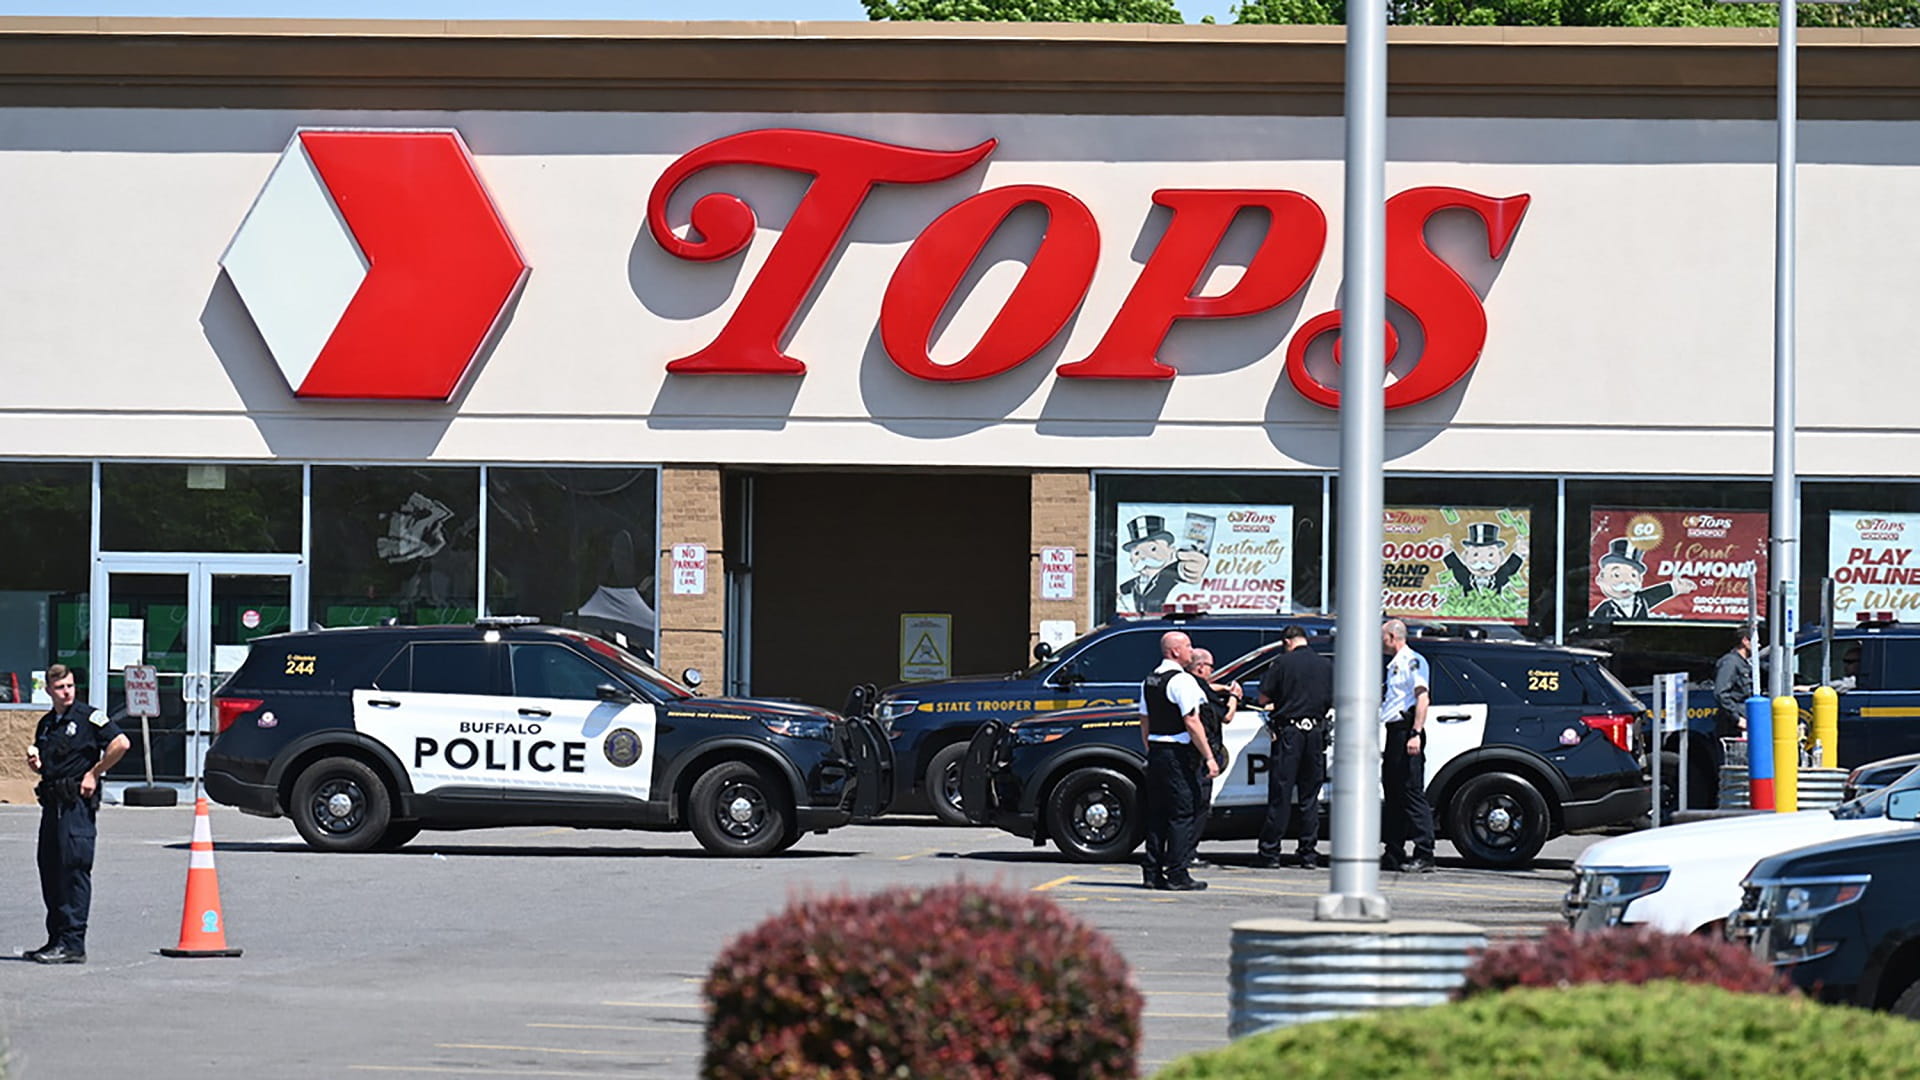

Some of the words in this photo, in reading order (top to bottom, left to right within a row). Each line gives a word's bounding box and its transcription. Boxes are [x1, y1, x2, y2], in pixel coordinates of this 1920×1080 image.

[1633, 523, 1655, 536] 60
[682, 549, 696, 559] NO
[1051, 552, 1065, 562] NO
[1382, 543, 1444, 562] 0,000
[1847, 548, 1913, 565] PLAY
[673, 560, 704, 570] PARKING
[1384, 564, 1429, 575] RAND
[1834, 567, 1920, 585] ONLINE
[1201, 578, 1285, 592] MILLIONS
[1383, 590, 1445, 608] inner
[285, 660, 314, 675] 244
[133, 670, 146, 680] NO
[1528, 677, 1560, 691] 245
[936, 702, 972, 712] STATE
[976, 701, 1032, 711] TROOPER
[460, 722, 542, 735] BUFFALO
[414, 737, 587, 773] POLICE
